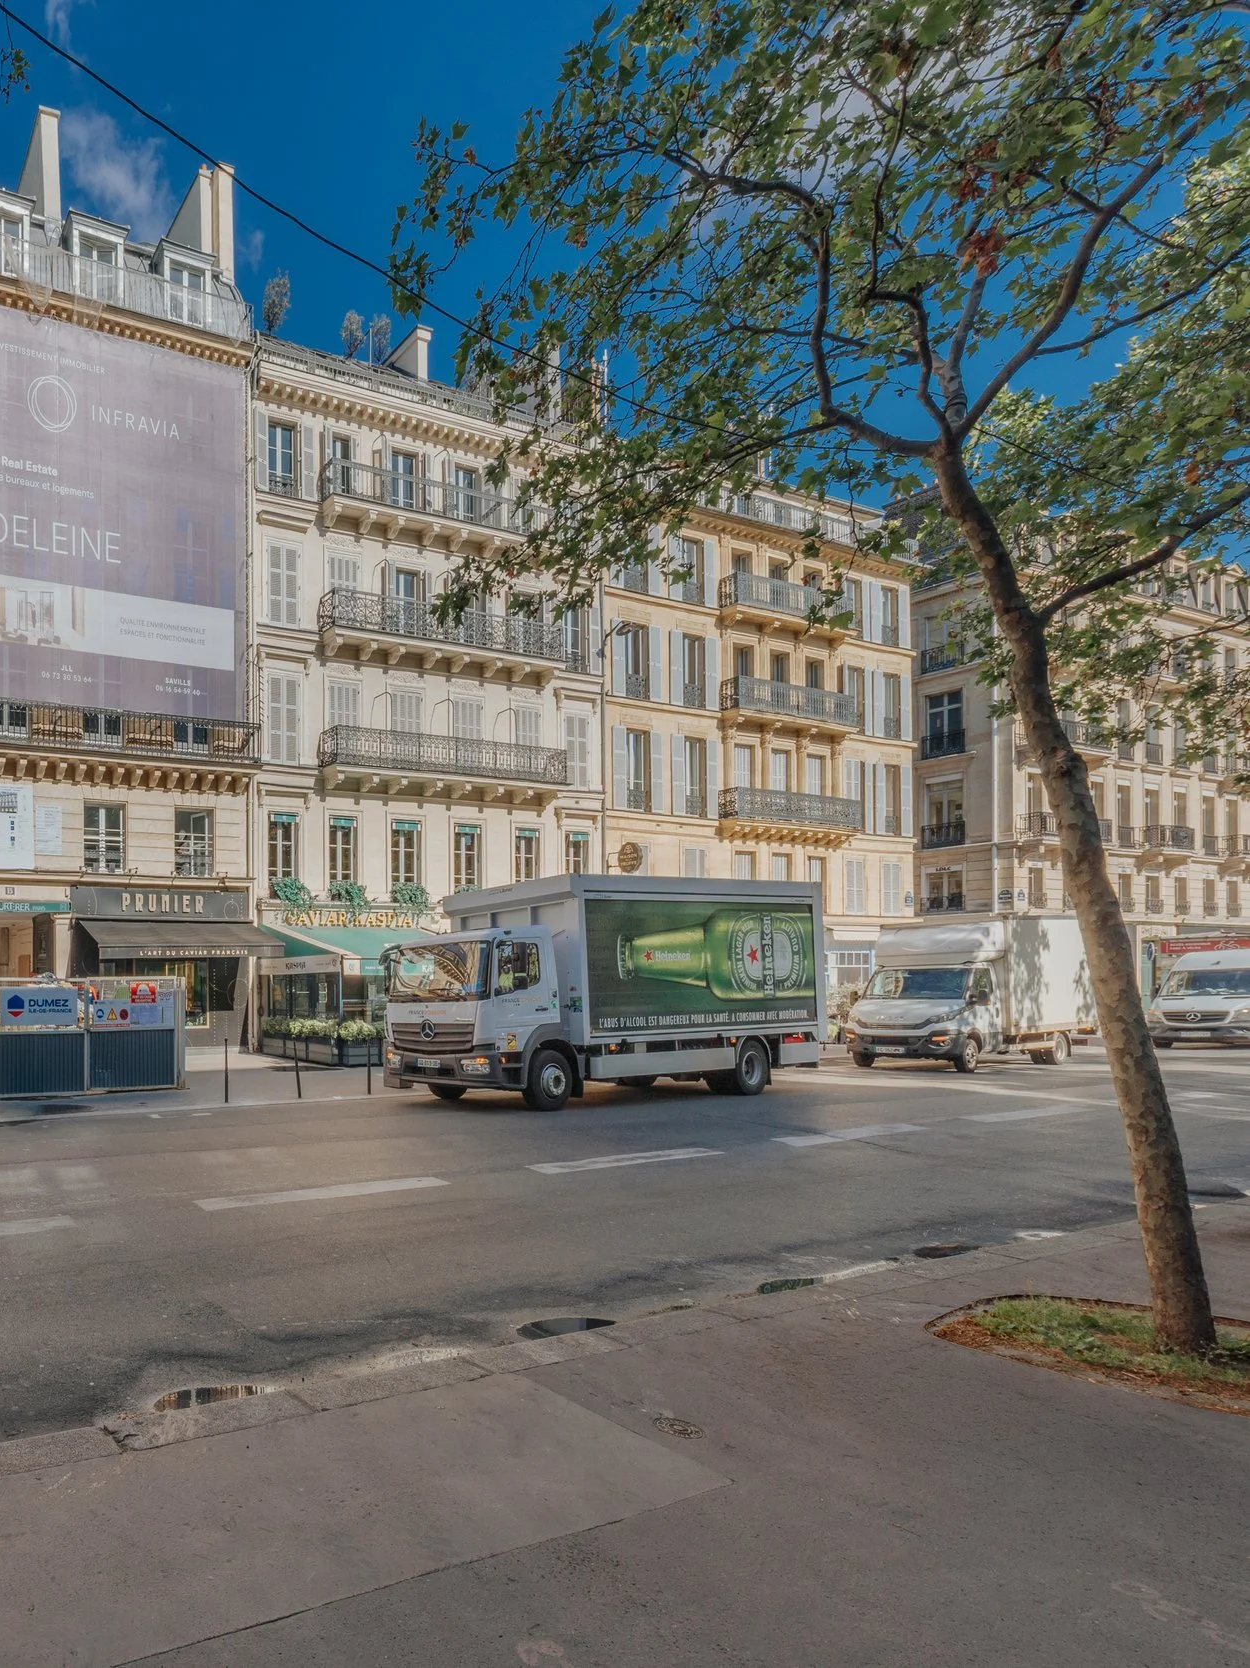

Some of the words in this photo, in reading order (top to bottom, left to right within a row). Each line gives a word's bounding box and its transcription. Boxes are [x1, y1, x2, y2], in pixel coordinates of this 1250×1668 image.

[60, 357, 105, 375] IMMOBILIER
[91, 404, 180, 440] INFRAVIA
[1, 455, 23, 470] Real
[26, 461, 58, 477] Estate
[5, 473, 40, 489] bureaux
[42, 479, 50, 490] et
[52, 481, 95, 499] logements
[120, 628, 146, 639] ESPACES
[148, 632, 155, 640] ET
[146, 619, 206, 636] ENVIRONNEMENTALE
[41, 670, 51, 679] 06
[52, 671, 61, 680] 73
[61, 664, 73, 673] JLL
[155, 684, 164, 692] 06
[165, 677, 191, 687] SAVILLS
[121, 892, 204, 914] PRUNIER
[285, 910, 349, 927] CAVIAR
[655, 950, 691, 961] Heineken
[762, 916, 775, 996] Heineken
[28, 999, 69, 1008] DUMEZ
[599, 1017, 618, 1029] L'ABUS
[620, 1016, 647, 1028] D'ALCOOL
[648, 1015, 658, 1026] EST
[659, 1014, 690, 1026] DANGEREUX
[691, 1013, 705, 1024] POUR
[706, 1013, 712, 1023] LA
[736, 1011, 766, 1022] CONSOMMER
[766, 1010, 778, 1021] AVEC
